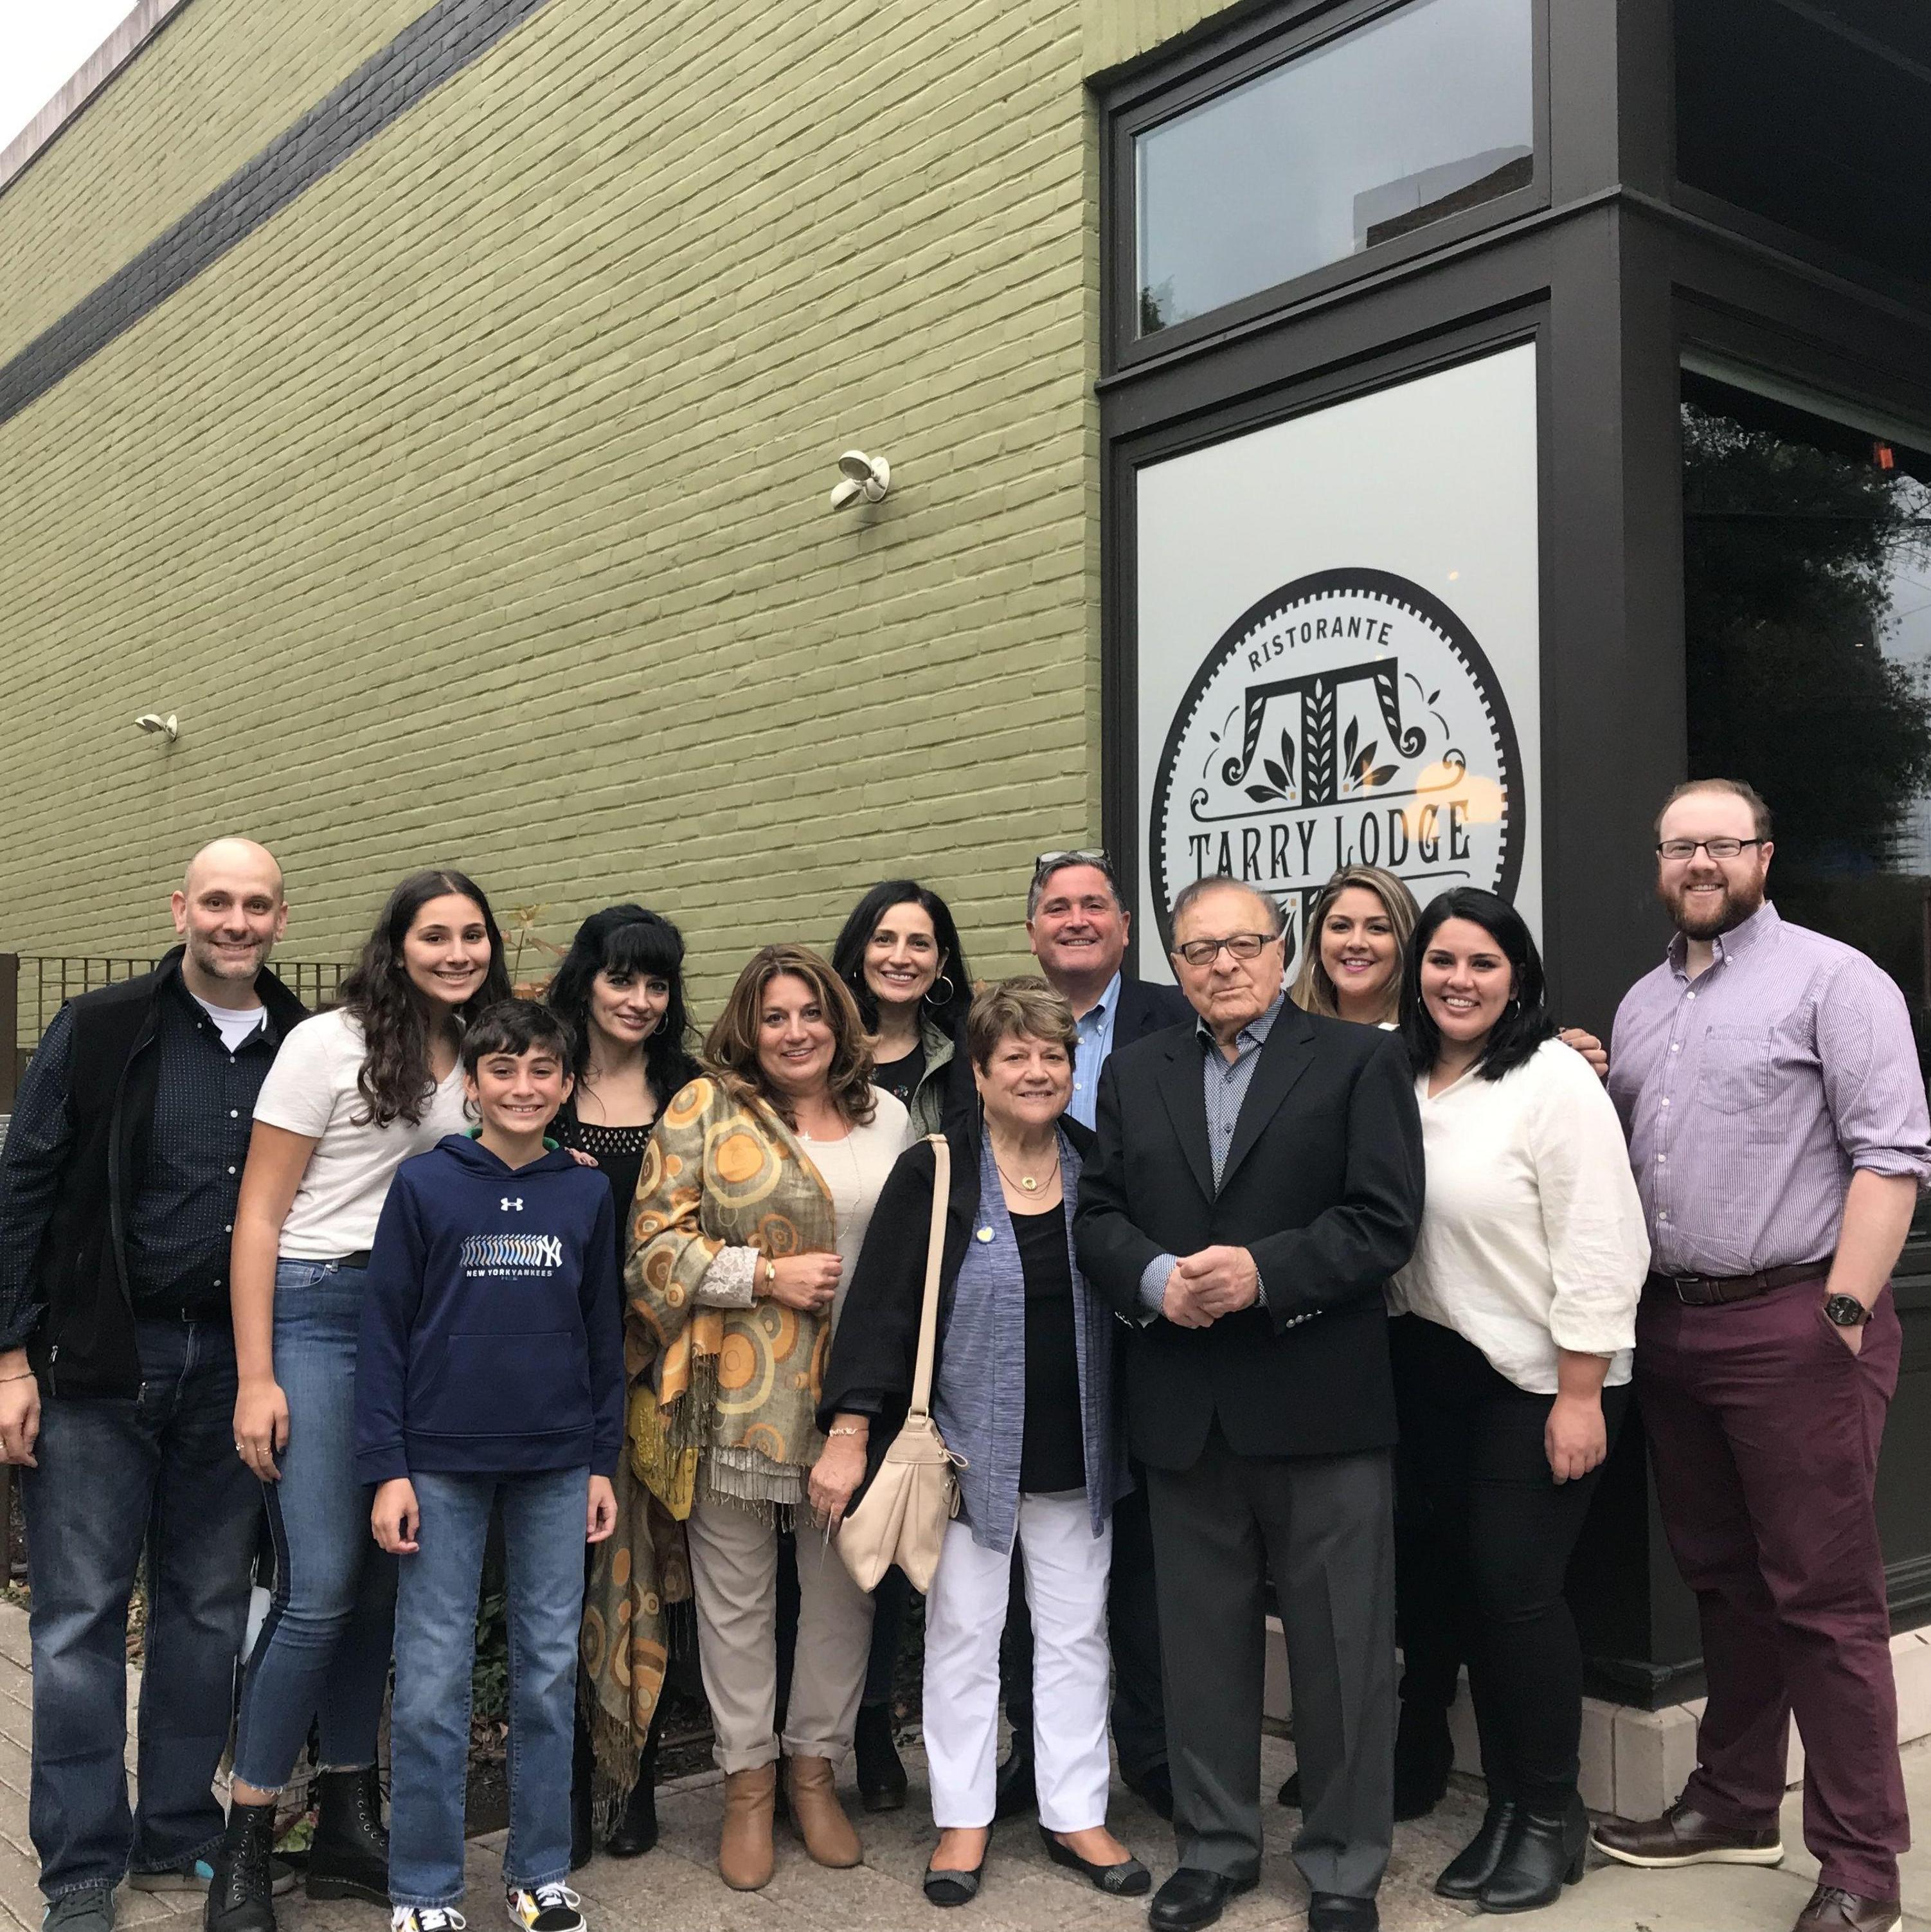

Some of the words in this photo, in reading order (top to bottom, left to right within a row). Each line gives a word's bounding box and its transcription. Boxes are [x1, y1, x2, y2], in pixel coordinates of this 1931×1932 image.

[1248, 615, 1394, 673] RISTORANTE
[1188, 818, 1318, 882] TARRY
[1333, 799, 1471, 873] LODGE
[466, 1269, 486, 1277] NEW
[488, 1268, 511, 1277] YORK
[511, 1268, 553, 1277] YANKEES
